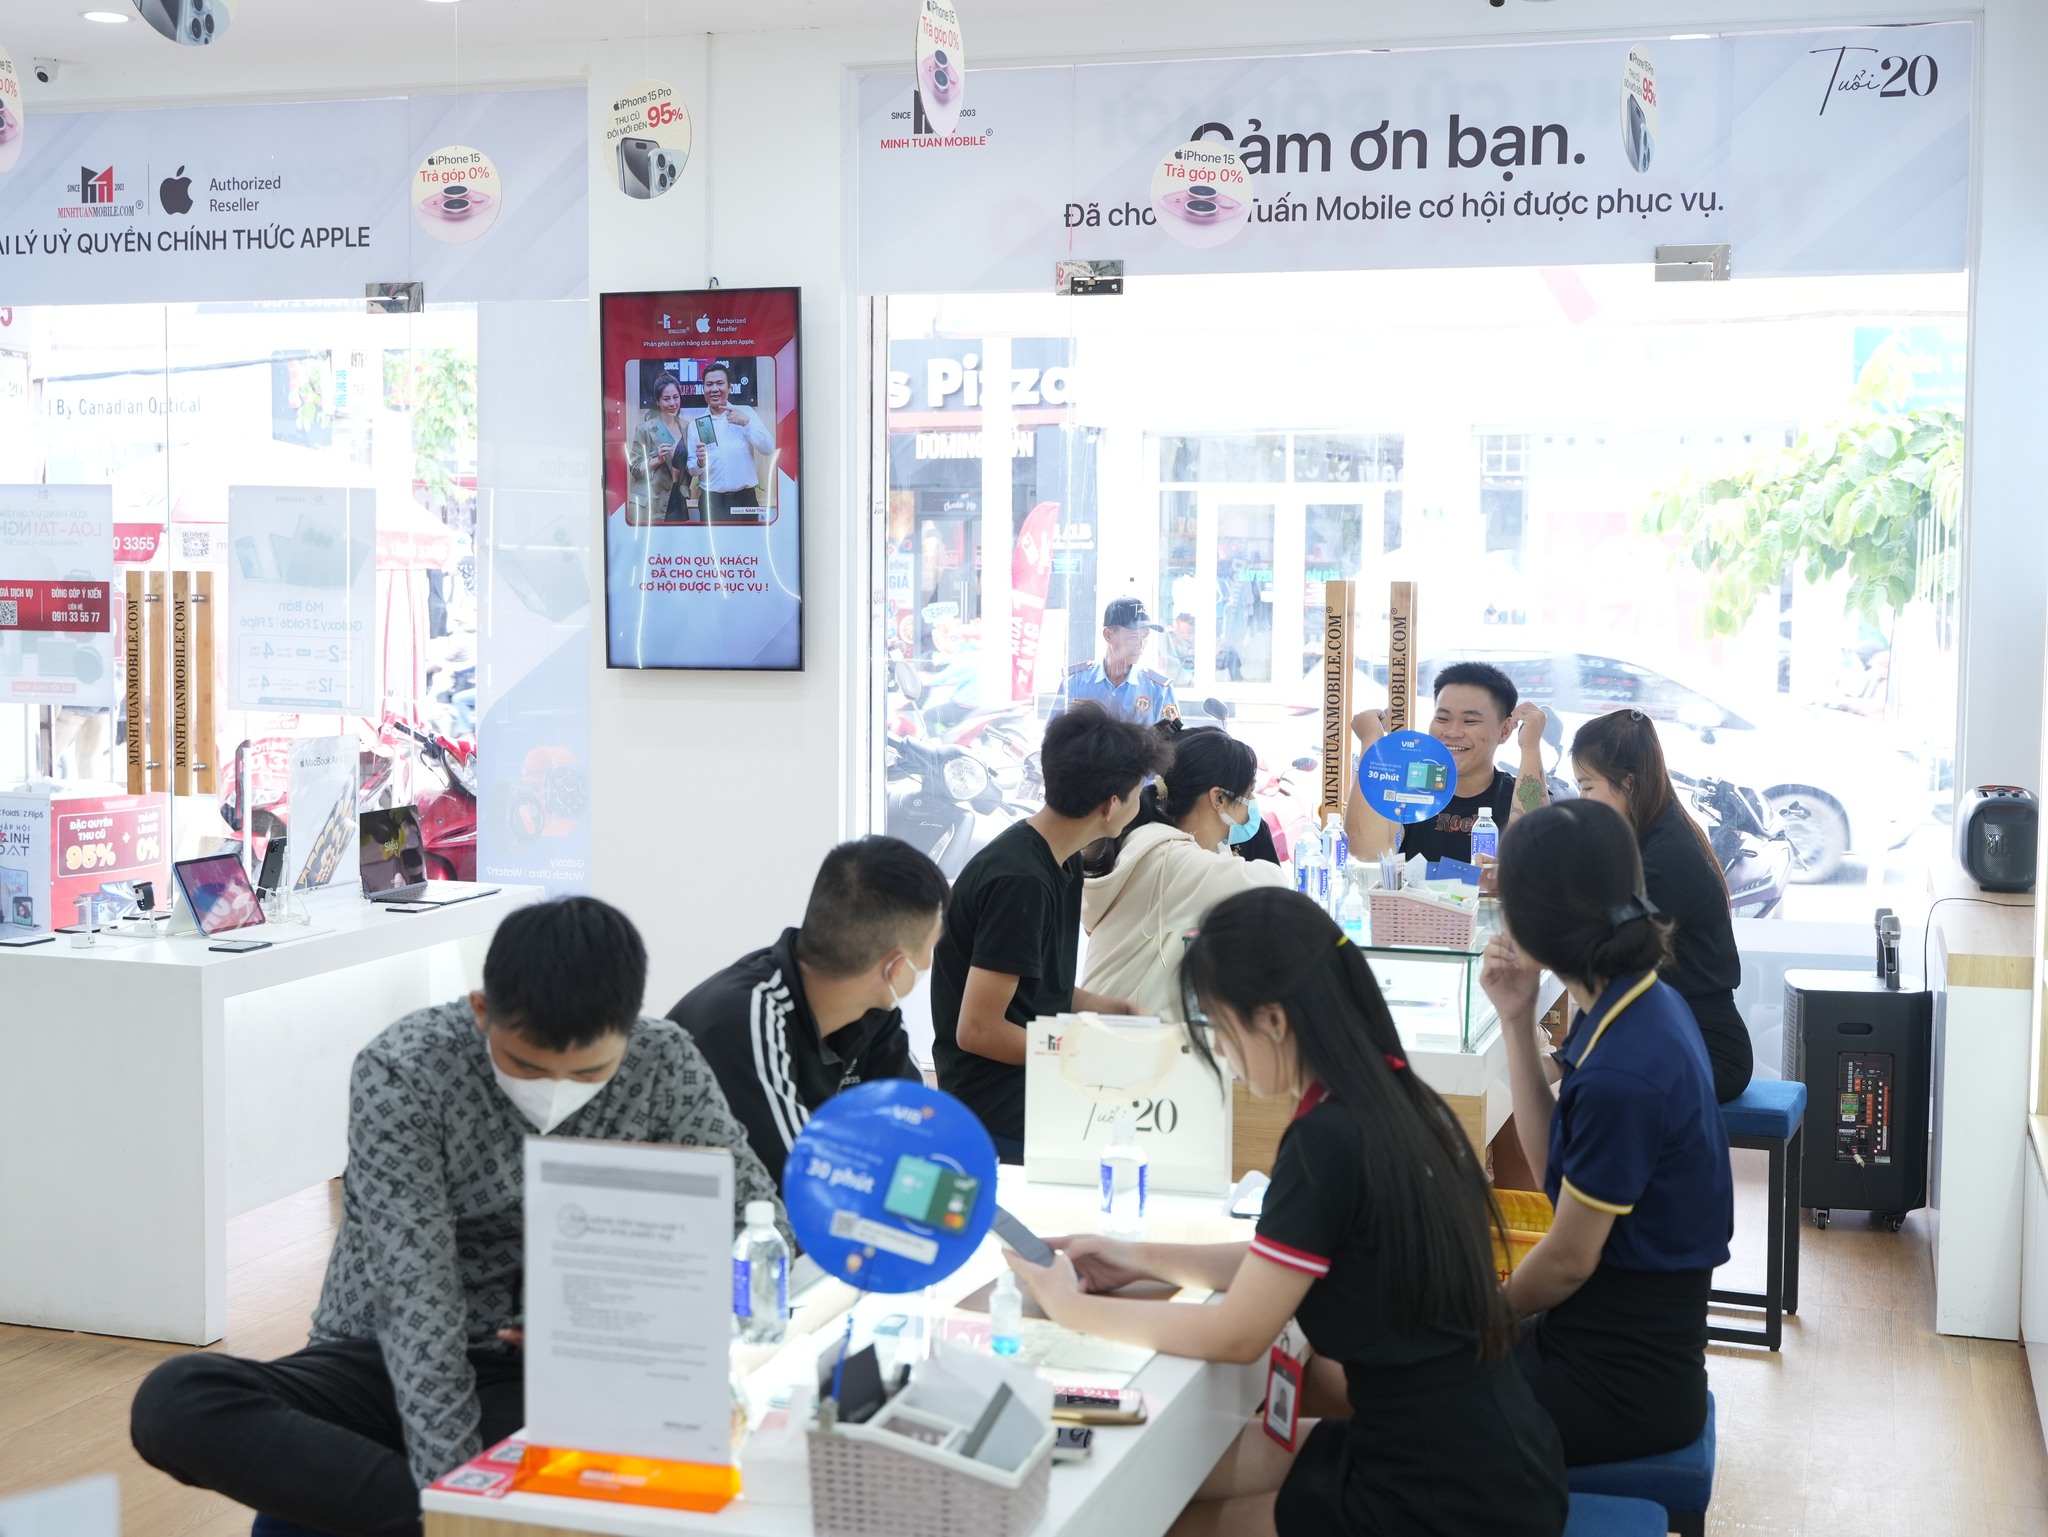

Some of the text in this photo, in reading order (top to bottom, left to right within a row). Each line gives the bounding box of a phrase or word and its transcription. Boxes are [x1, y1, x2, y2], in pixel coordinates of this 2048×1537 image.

[948, 29, 959, 50] 0%
[1879, 54, 1938, 97] 20
[620, 88, 672, 109] iPhone 15 Pro
[1643, 77, 1656, 107] 95%
[615, 115, 629, 125] THU
[648, 102, 683, 128] 95%
[891, 112, 911, 120] SINCE
[880, 136, 986, 149] MINH TUAN MOBILE
[1350, 120, 1428, 171] ơn
[1448, 114, 1586, 182] bạn.
[435, 153, 480, 165] iPhone 15
[1184, 150, 1235, 165] iPhone 15
[442, 168, 465, 183] góp
[468, 167, 490, 179] 0%
[1163, 163, 1243, 183] Trả góp 0%
[67, 183, 124, 192] SINCE 2003
[209, 176, 281, 191] Authorized
[58, 206, 135, 218] MINHTUANMOBILE.COM
[209, 198, 260, 212] Reseller
[1064, 202, 1101, 227] Đã
[1108, 201, 1156, 226] cho
[1316, 195, 1411, 221] Mobile
[1419, 193, 1454, 218] cơ
[1462, 191, 1505, 223] hội
[1513, 190, 1588, 222] được
[1596, 188, 1672, 220] phục
[1680, 191, 1724, 218] vụ.
[15, 229, 38, 255] LÝ
[77, 226, 152, 255] QUYỀN
[157, 225, 227, 251] CHÍNH
[233, 222, 295, 250] THỨC
[300, 226, 370, 248] APPLE
[926, 353, 1070, 408] Piza
[79, 398, 143, 416] Canadian
[149, 397, 201, 417] Optical
[123, 536, 155, 550] 3355
[648, 554, 672, 565] CẢM
[675, 556, 691, 565] ƠN
[720, 554, 758, 565] KHÁCH
[651, 568, 667, 578] ĐÃ
[669, 569, 693, 578] CHO
[738, 568, 756, 578] TÔI
[68, 587, 81, 599] GÓP
[657, 581, 676, 593] HỘI
[679, 582, 711, 593] ĐƯỢC
[747, 583, 762, 593] VỤ
[52, 611, 100, 623] 0911 33 55 77
[128, 599, 139, 766] MINHTUANMOBILE.COM
[175, 600, 186, 768] MINHTUANMOBILE.COM
[1325, 614, 1342, 807] MINHTUANMOBILE.COM
[305, 757, 331, 767] MacBook
[1368, 770, 1400, 781] 30 phút
[2, 809, 20, 817] Fold5
[28, 810, 44, 819] Flip5
[78, 831, 94, 841] THU
[65, 842, 116, 870] 95%
[136, 836, 160, 862] 0%
[1132, 1098, 1178, 1134] 20
